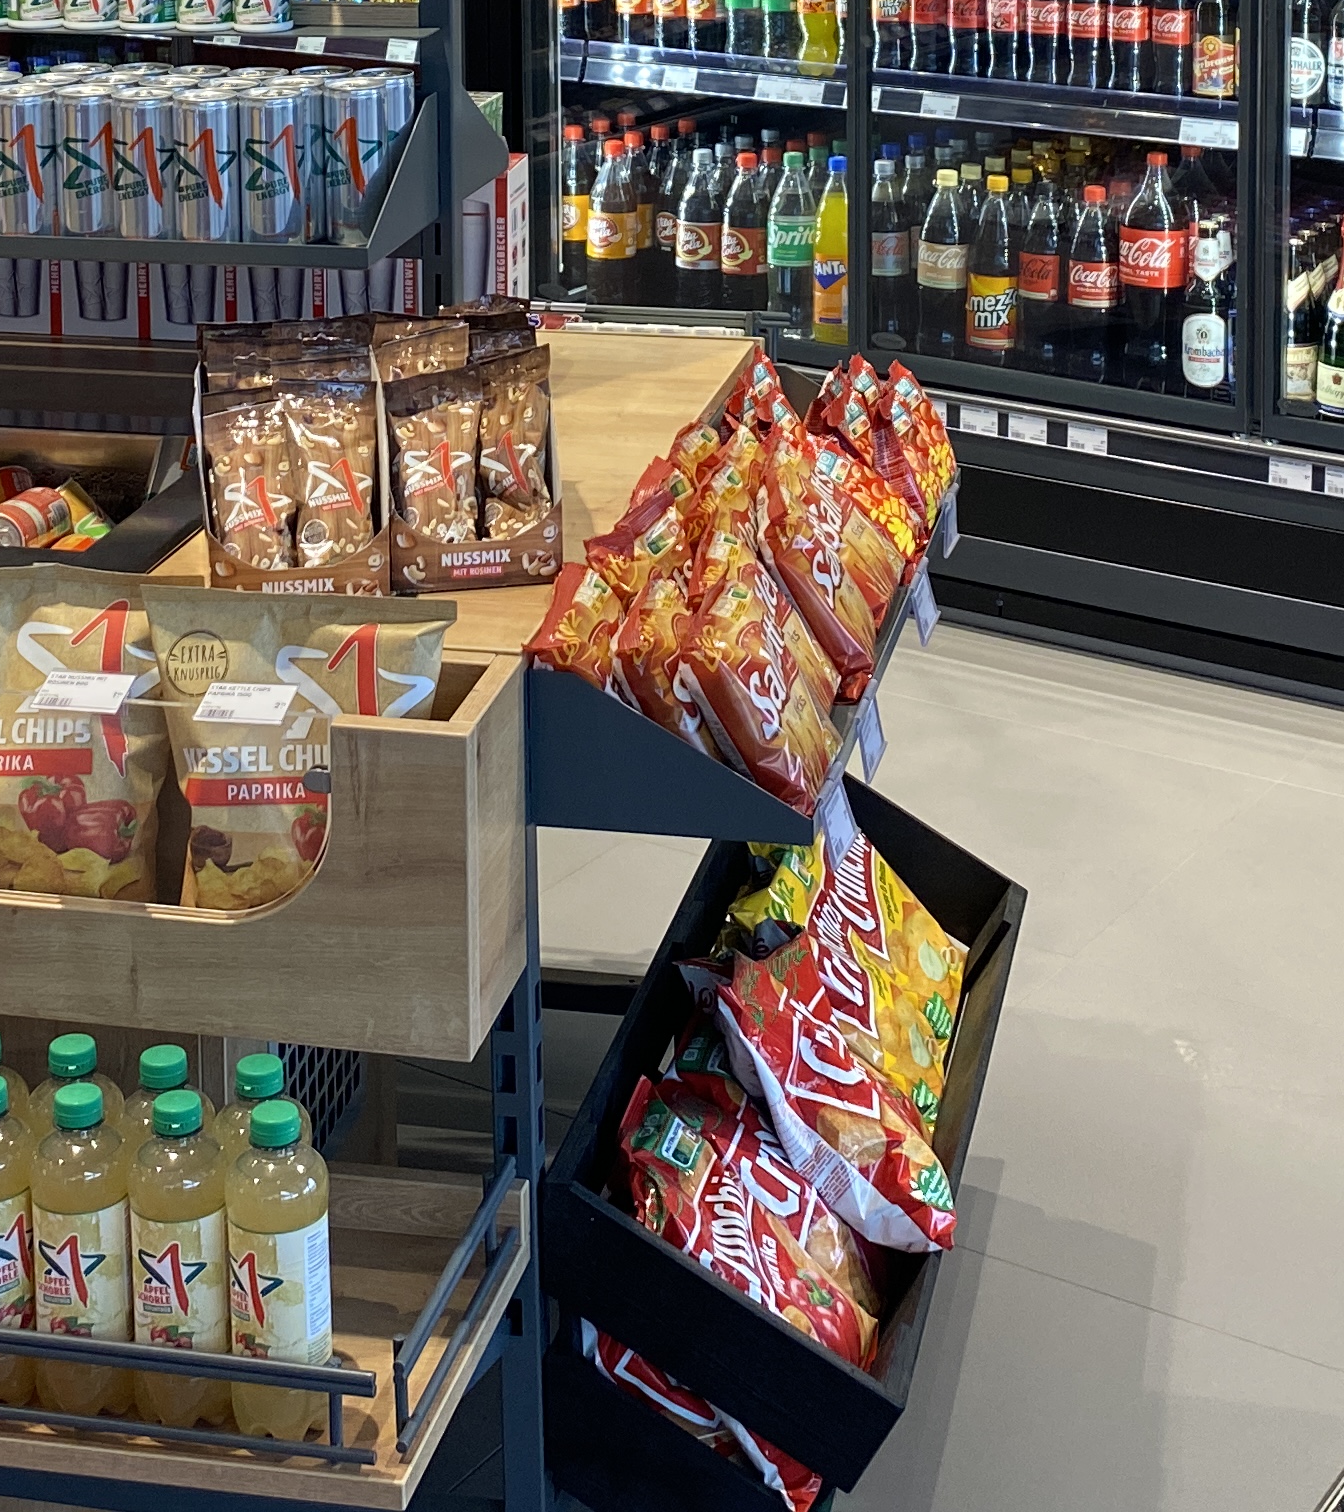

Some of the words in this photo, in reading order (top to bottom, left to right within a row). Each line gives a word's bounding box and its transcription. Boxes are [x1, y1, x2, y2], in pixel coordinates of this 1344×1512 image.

[974, 308, 1009, 329] mix
[308, 492, 350, 508] NUSSMIX
[441, 549, 512, 567] NUSSMIX
[453, 567, 468, 576] MIT
[469, 566, 503, 575] ROSINEN
[262, 578, 335, 594] NUSSMIX
[180, 646, 215, 664] EXTRA
[173, 665, 221, 681] KNUSPRIG
[11, 717, 91, 745] CHIPS
[227, 783, 307, 801] PAPRIKA
[144, 1284, 170, 1296] APFEL
